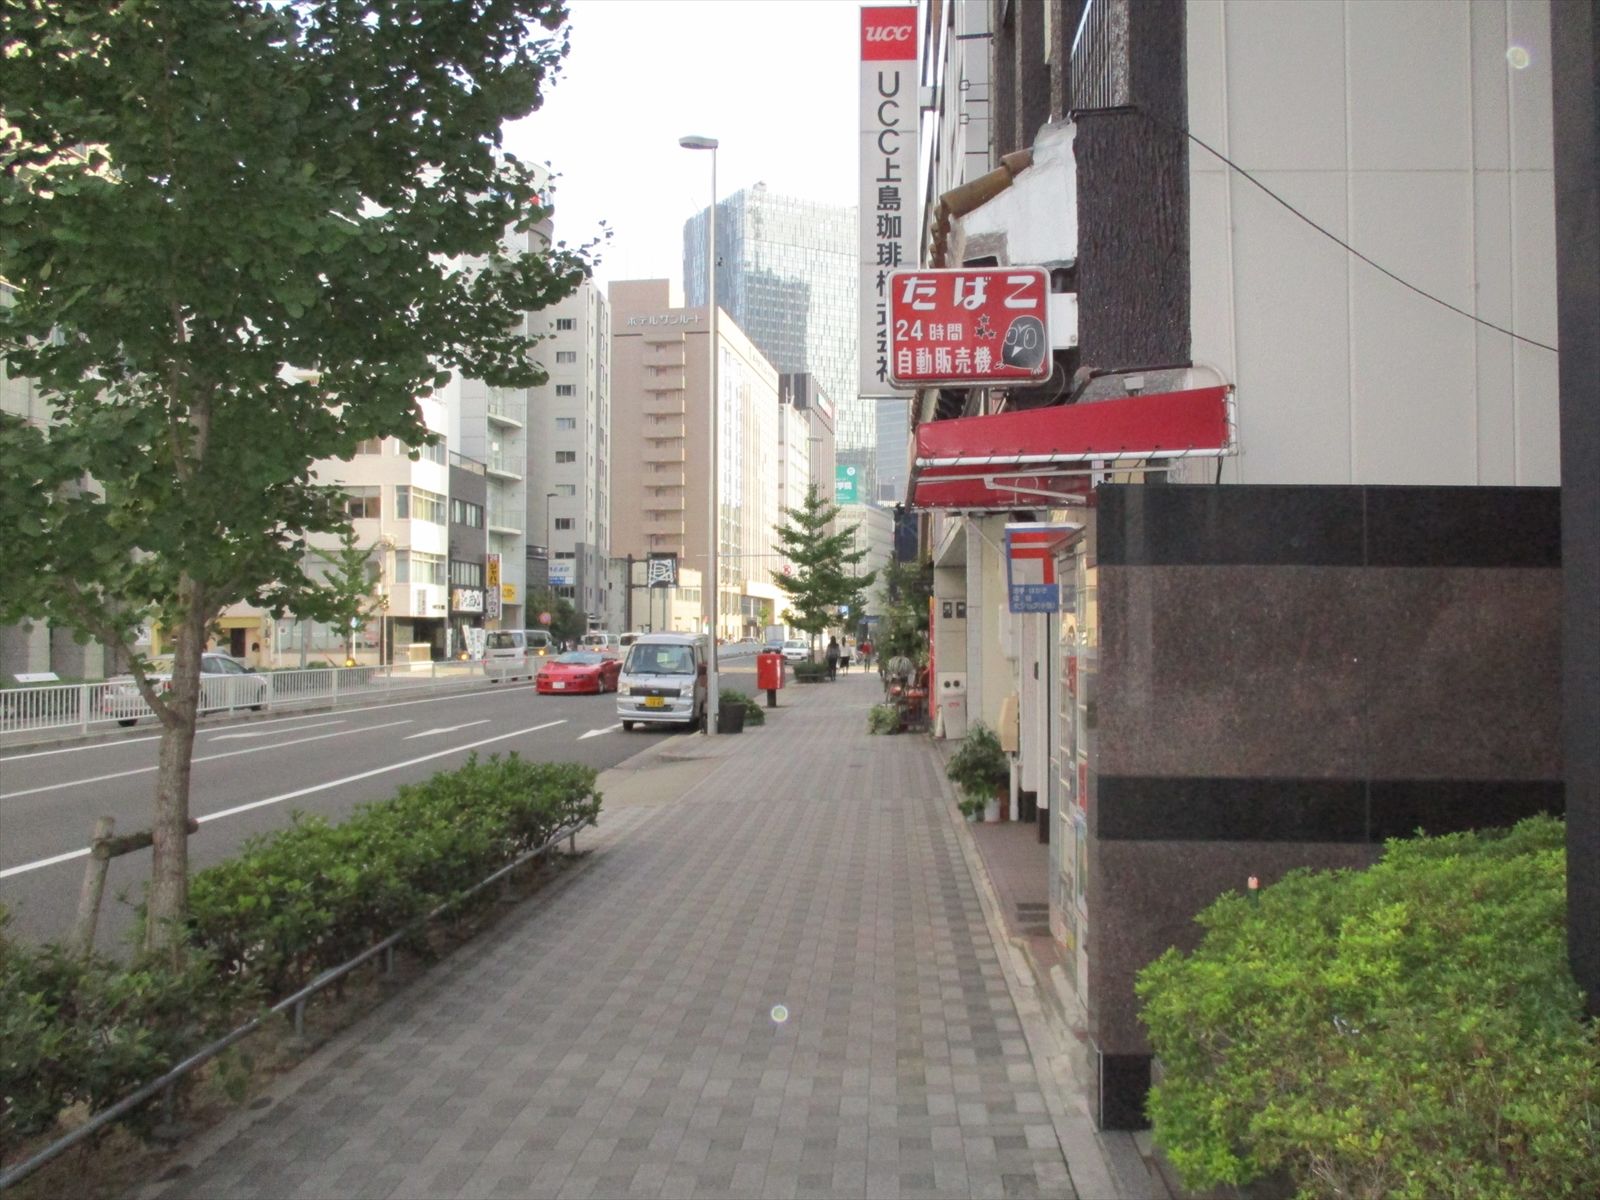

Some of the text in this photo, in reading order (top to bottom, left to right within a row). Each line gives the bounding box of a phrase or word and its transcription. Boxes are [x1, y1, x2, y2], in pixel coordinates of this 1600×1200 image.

[902, 275, 1037, 311] たばこ
[897, 346, 992, 375] 自動販売機
